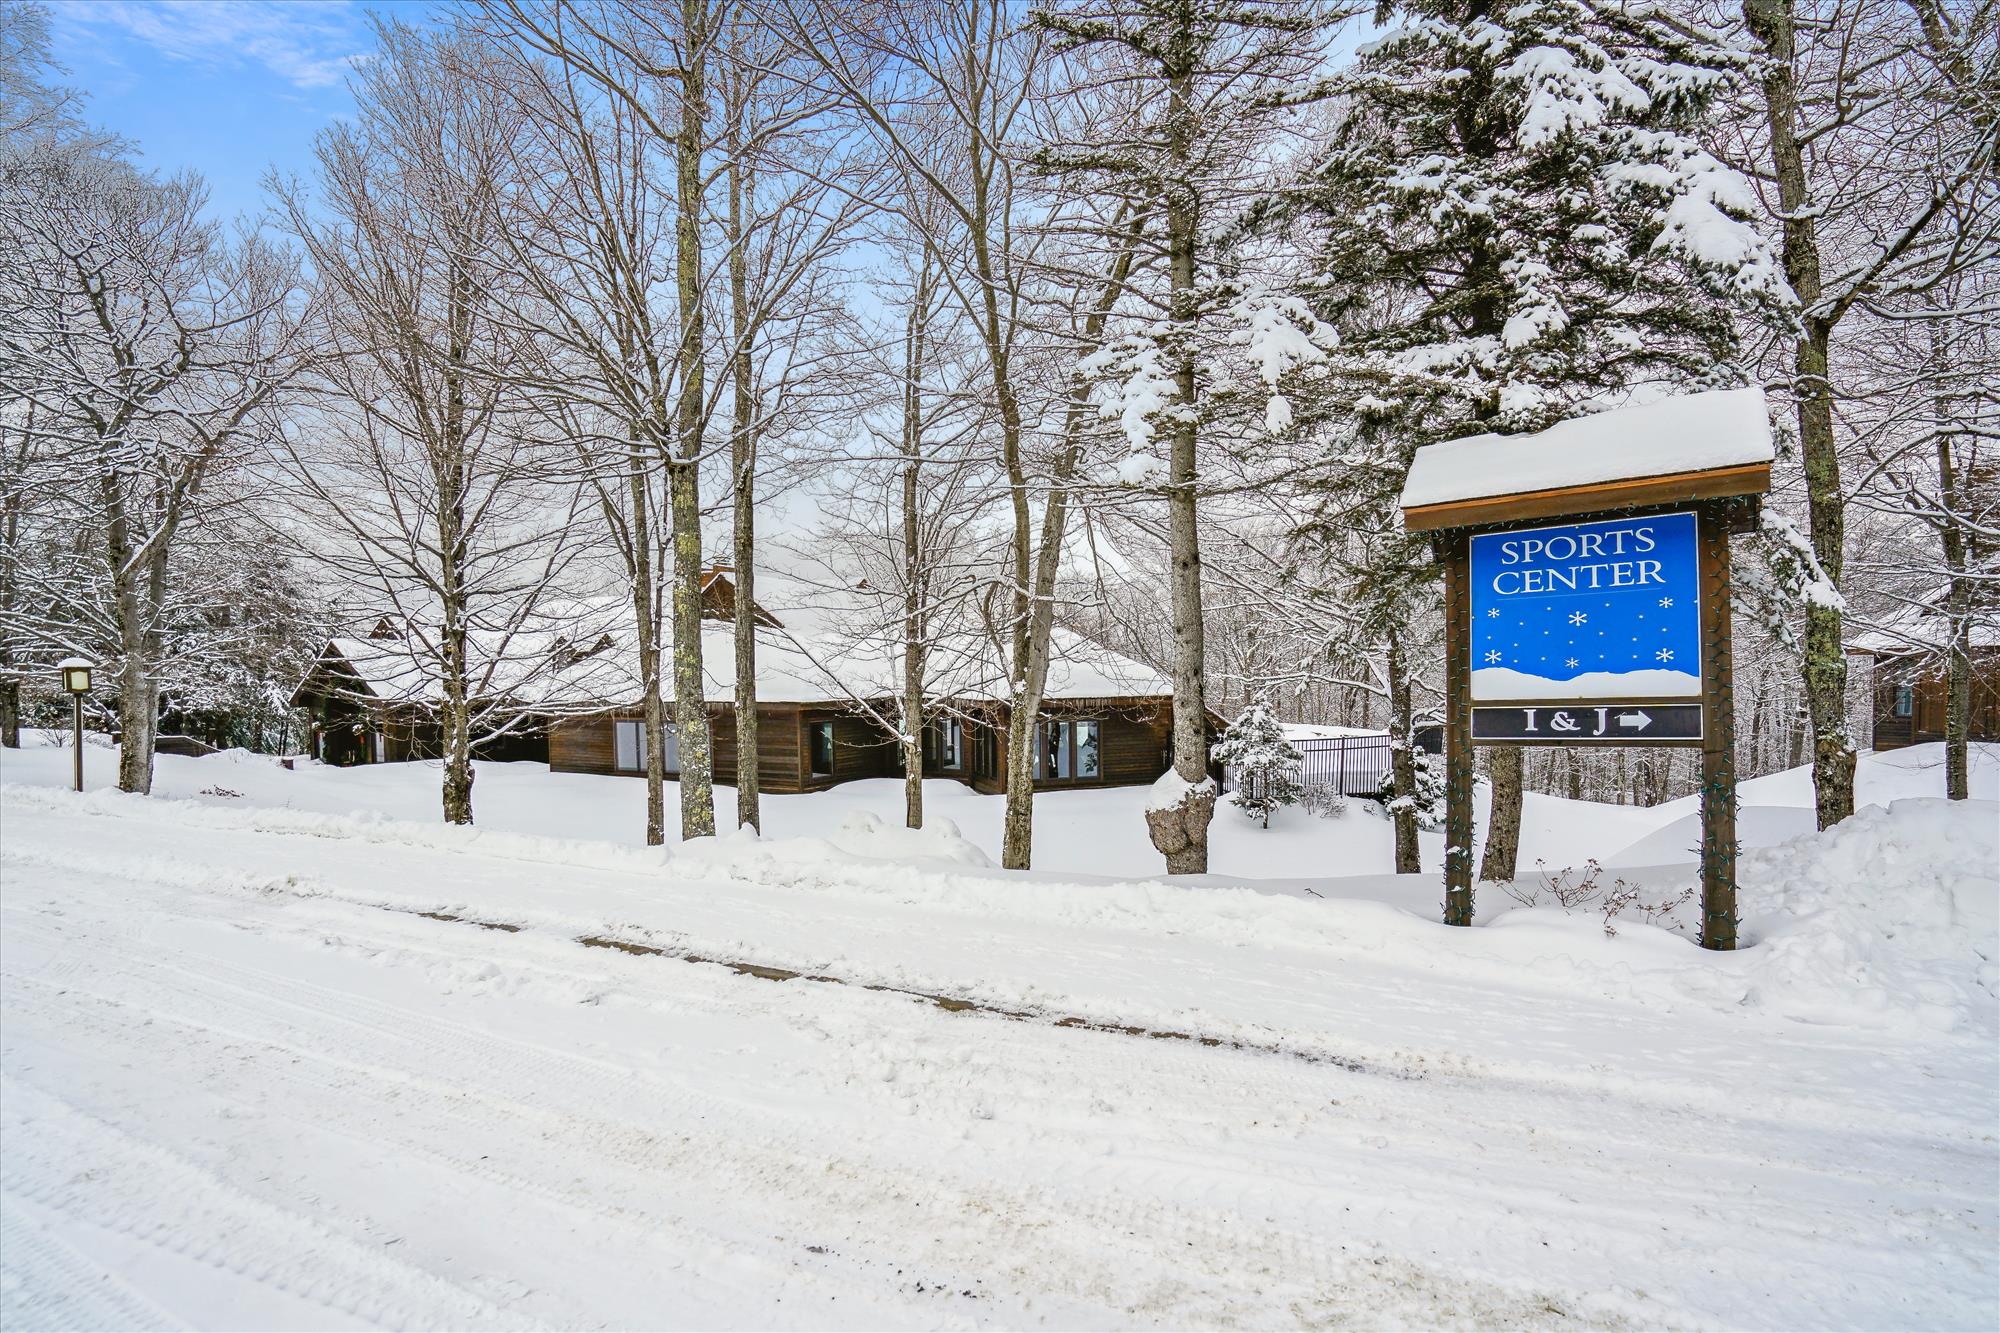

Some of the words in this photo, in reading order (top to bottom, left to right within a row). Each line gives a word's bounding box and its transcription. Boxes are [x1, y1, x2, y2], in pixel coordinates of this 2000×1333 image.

[1501, 527, 1656, 565] SPORTS
[1492, 560, 1667, 596] CENTER
[1523, 708, 1539, 732] I
[1550, 711, 1581, 731] &
[1591, 707, 1609, 737] J
